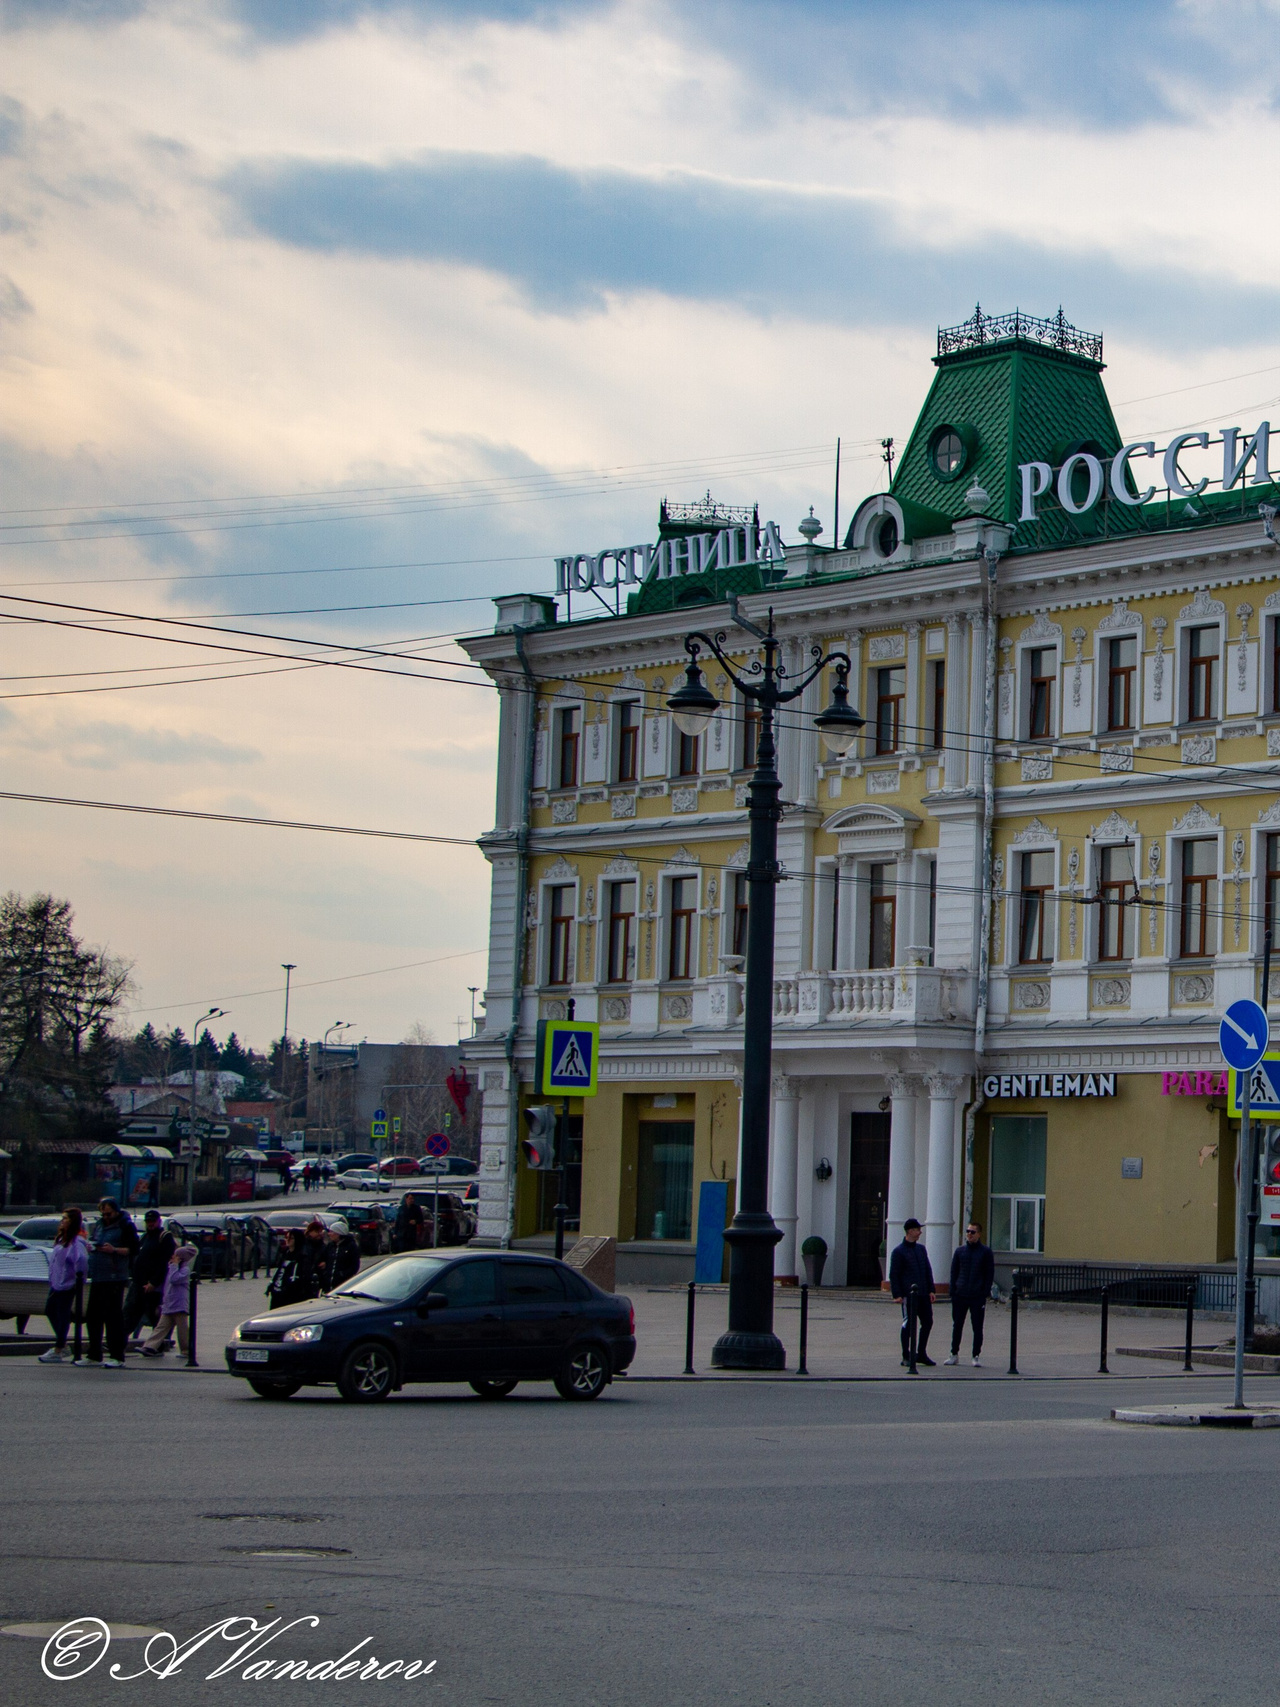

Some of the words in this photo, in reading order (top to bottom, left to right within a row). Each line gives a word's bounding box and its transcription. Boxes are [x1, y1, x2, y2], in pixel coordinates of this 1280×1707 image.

[554, 520, 786, 596] ГОСТИНИЦА
[984, 1073, 1117, 1098] GENTLEMAN
[1160, 1070, 1228, 1096] PARA
